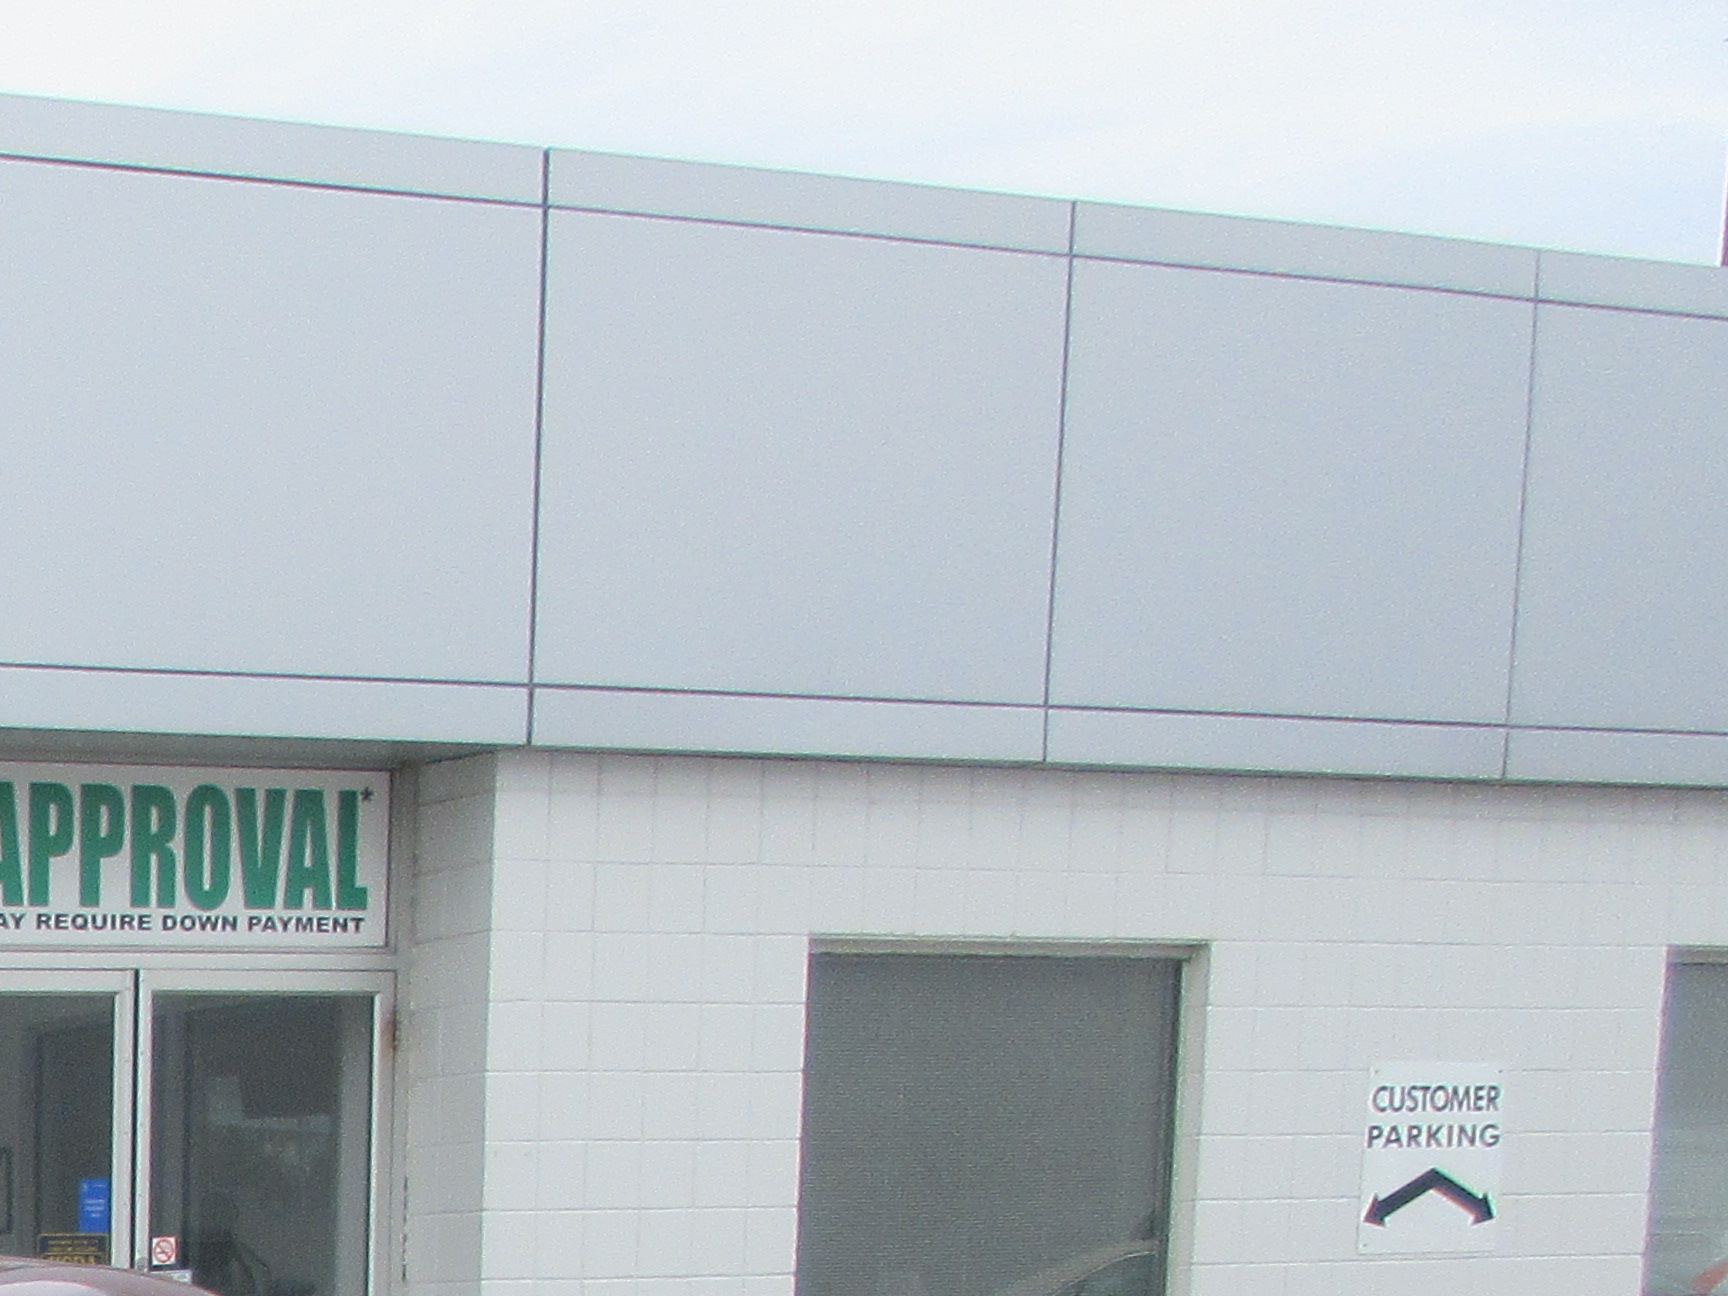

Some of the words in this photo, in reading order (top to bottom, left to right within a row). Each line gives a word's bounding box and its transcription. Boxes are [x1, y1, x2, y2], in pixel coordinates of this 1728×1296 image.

[35, 912, 153, 932] REQUIRE
[161, 914, 239, 933] DOWN
[247, 914, 366, 935] PAYMENT
[1371, 1084, 1501, 1113] CUSTOMER
[1367, 1124, 1501, 1149] PARKING
